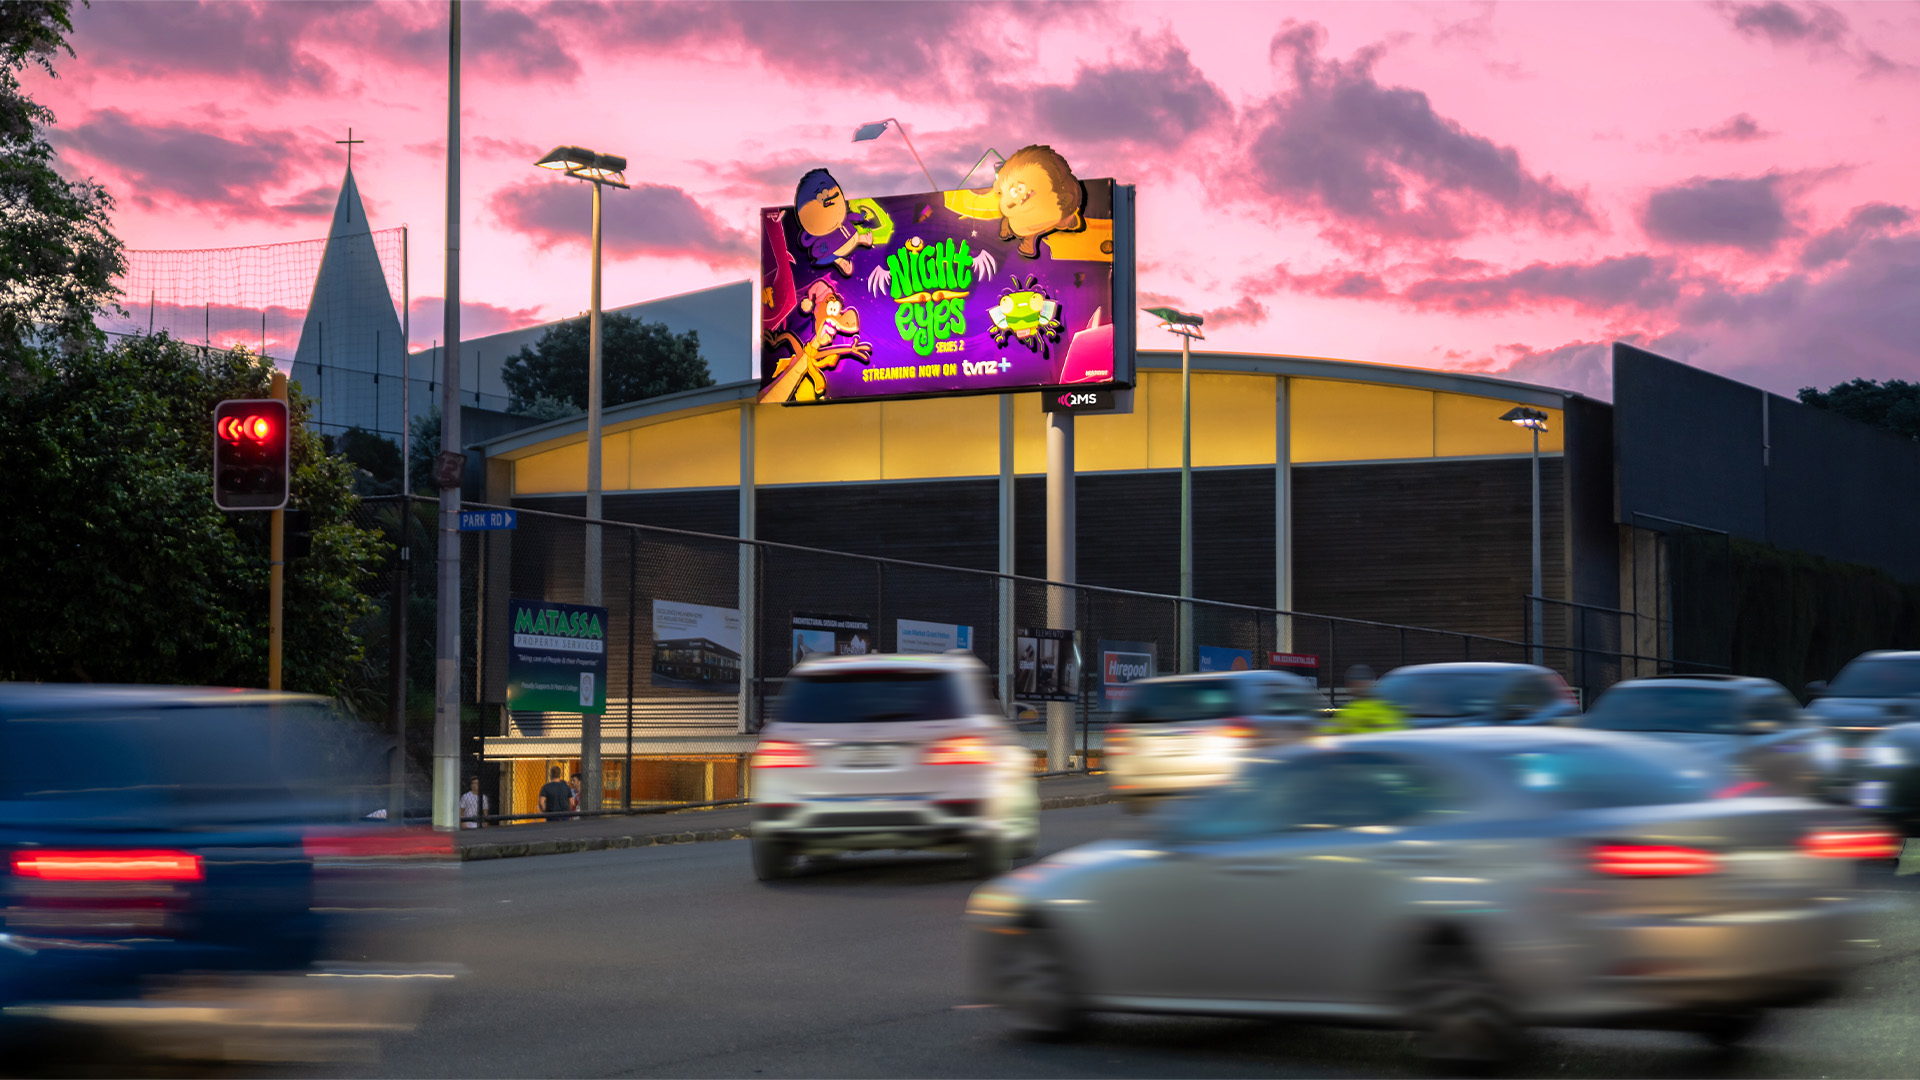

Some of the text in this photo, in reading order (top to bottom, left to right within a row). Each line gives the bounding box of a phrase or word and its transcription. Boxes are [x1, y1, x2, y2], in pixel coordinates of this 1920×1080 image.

[894, 297, 966, 356] eyes
[935, 340, 965, 353] SERIES 2
[862, 365, 916, 383] STREAMING
[918, 364, 941, 378] NOW
[943, 363, 957, 377] ON
[1063, 392, 1097, 408] QMS
[463, 513, 502, 528] PARK RD
[514, 607, 603, 639] MATASSA
[792, 617, 823, 626] ARCHITECTURAL
[823, 619, 837, 628] DESIGN
[845, 621, 869, 630] CONSENTING
[1035, 629, 1064, 639] ELEMENTO
[517, 636, 599, 651] PROPERTY SERVICES
[547, 656, 561, 664] People
[1108, 660, 1148, 681] Hirepool
